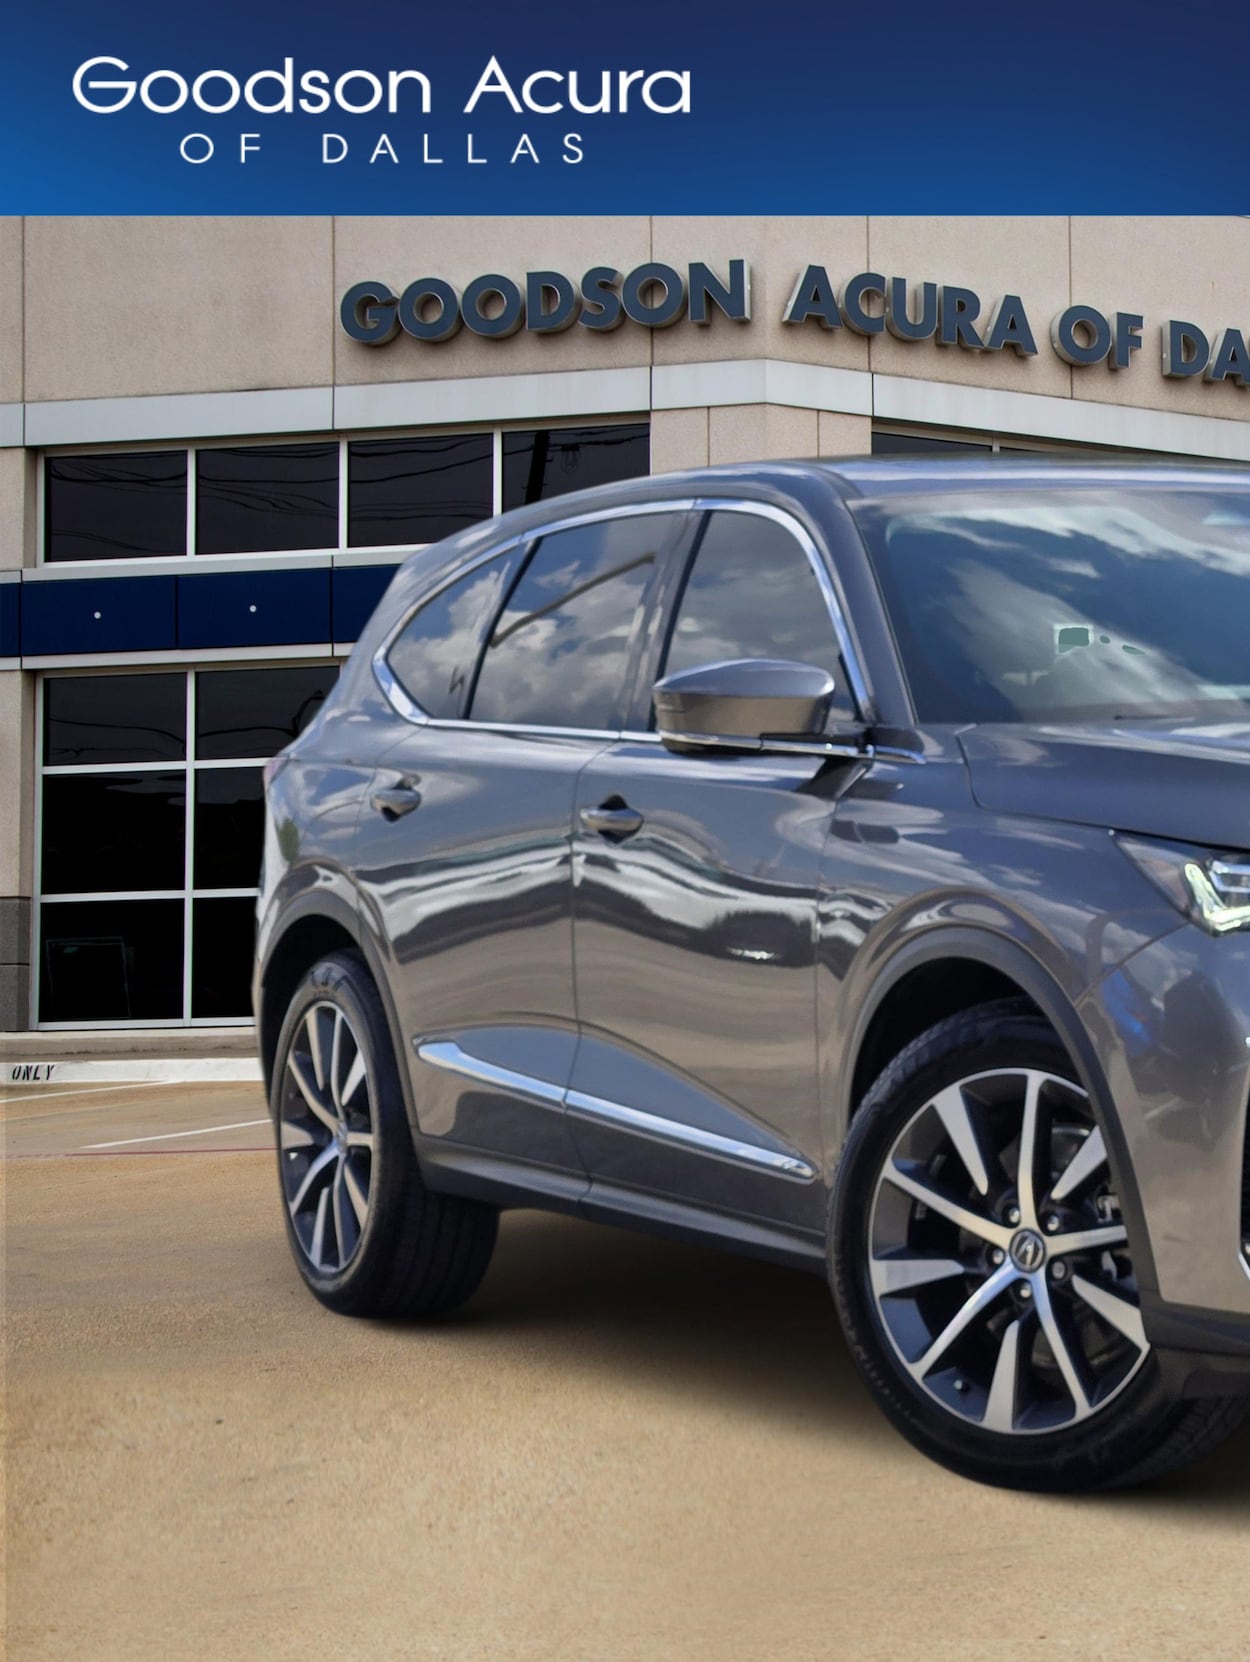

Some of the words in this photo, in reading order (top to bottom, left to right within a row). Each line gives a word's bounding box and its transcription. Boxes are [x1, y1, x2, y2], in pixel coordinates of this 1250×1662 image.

[340, 258, 752, 346] GOODSON
[782, 264, 1038, 357] ACURA
[1050, 304, 1144, 370] OF
[11, 1064, 55, 1081] ONLY
